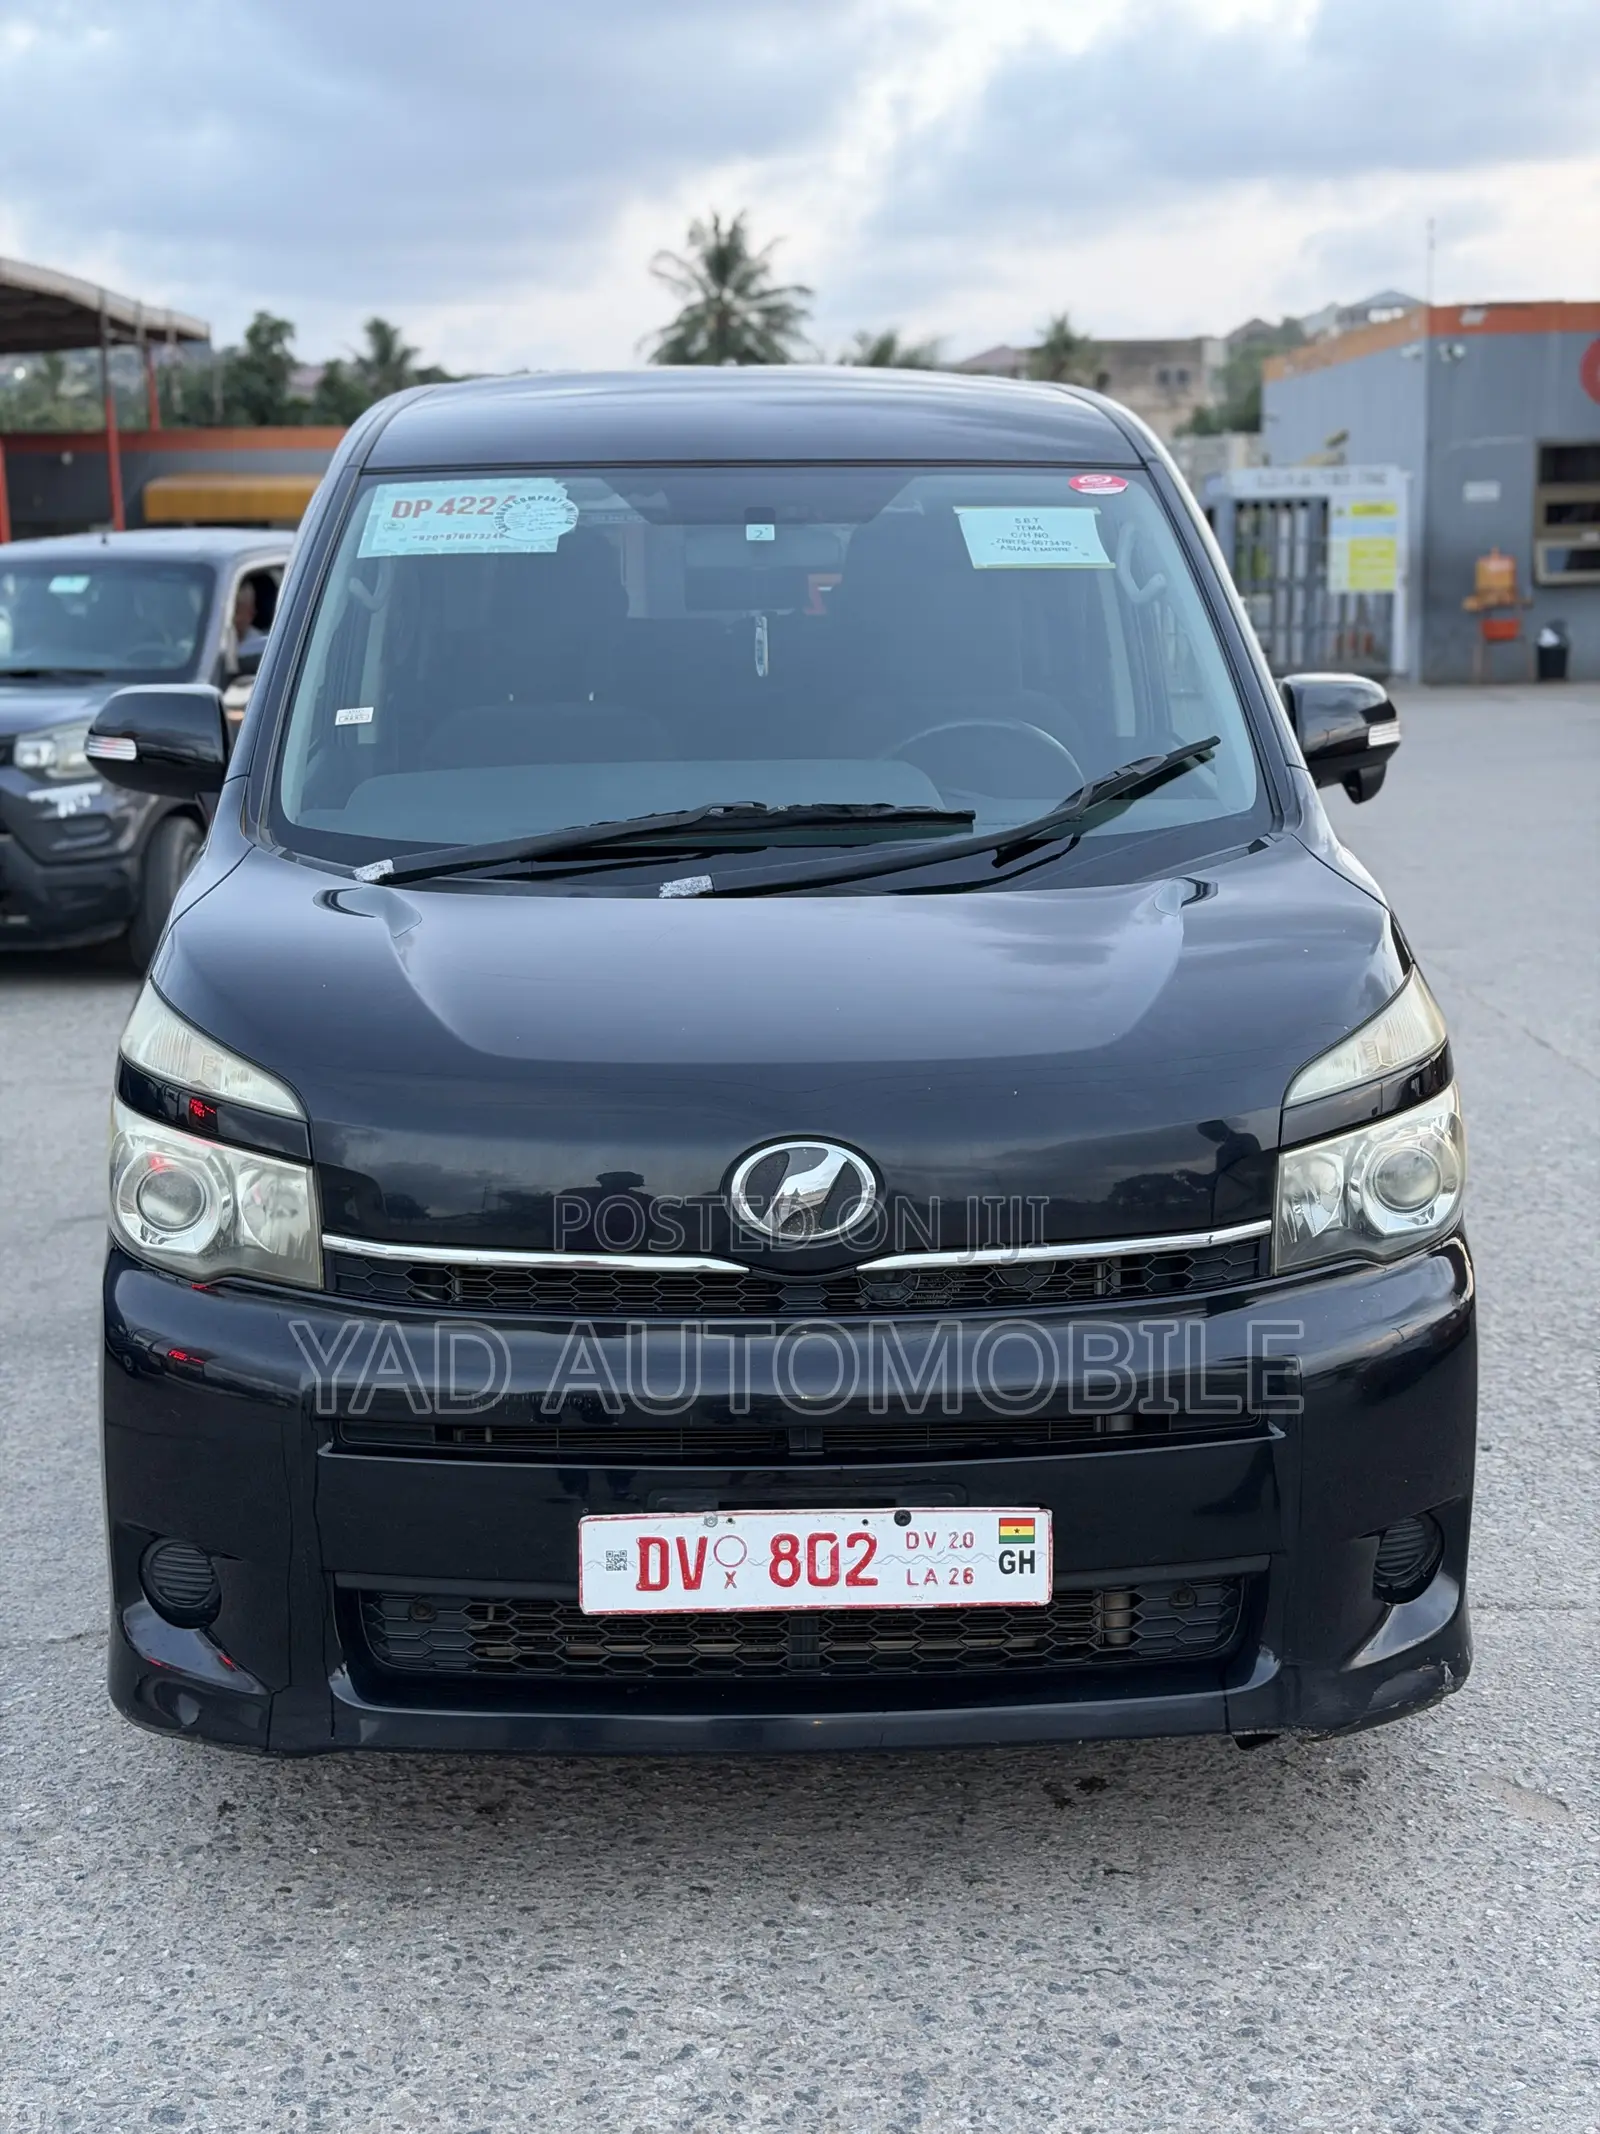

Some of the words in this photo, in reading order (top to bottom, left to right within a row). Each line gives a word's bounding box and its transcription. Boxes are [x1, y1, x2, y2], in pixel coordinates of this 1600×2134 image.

[391, 499, 433, 518] DP
[906, 1531, 937, 1549] DV
[636, 1535, 708, 1592] DV
[769, 1532, 879, 1588] 802
[999, 1550, 1036, 1574] GH
[906, 1567, 938, 1586] LA
[948, 1567, 975, 1585] 26
